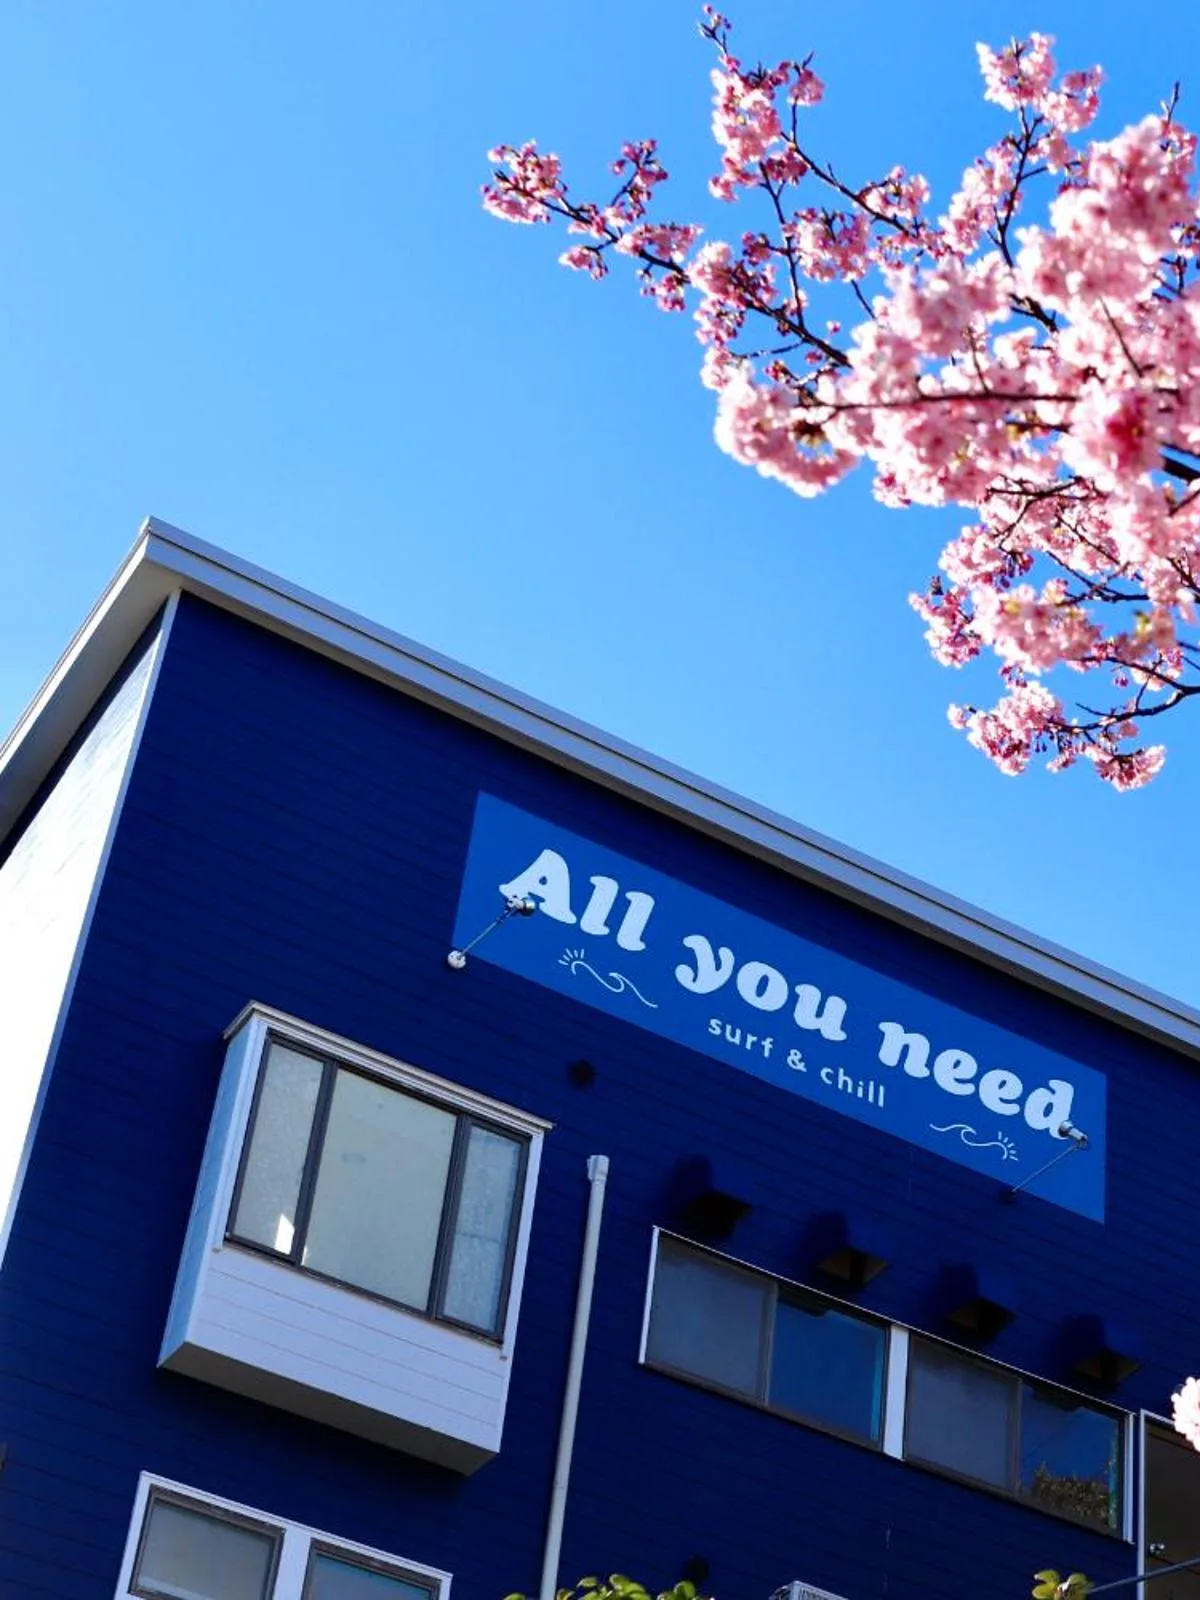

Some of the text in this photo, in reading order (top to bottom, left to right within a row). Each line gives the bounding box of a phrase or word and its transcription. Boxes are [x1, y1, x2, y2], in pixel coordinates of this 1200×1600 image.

[499, 849, 1074, 1140] All you need
[708, 1018, 885, 1107] surf & chill
